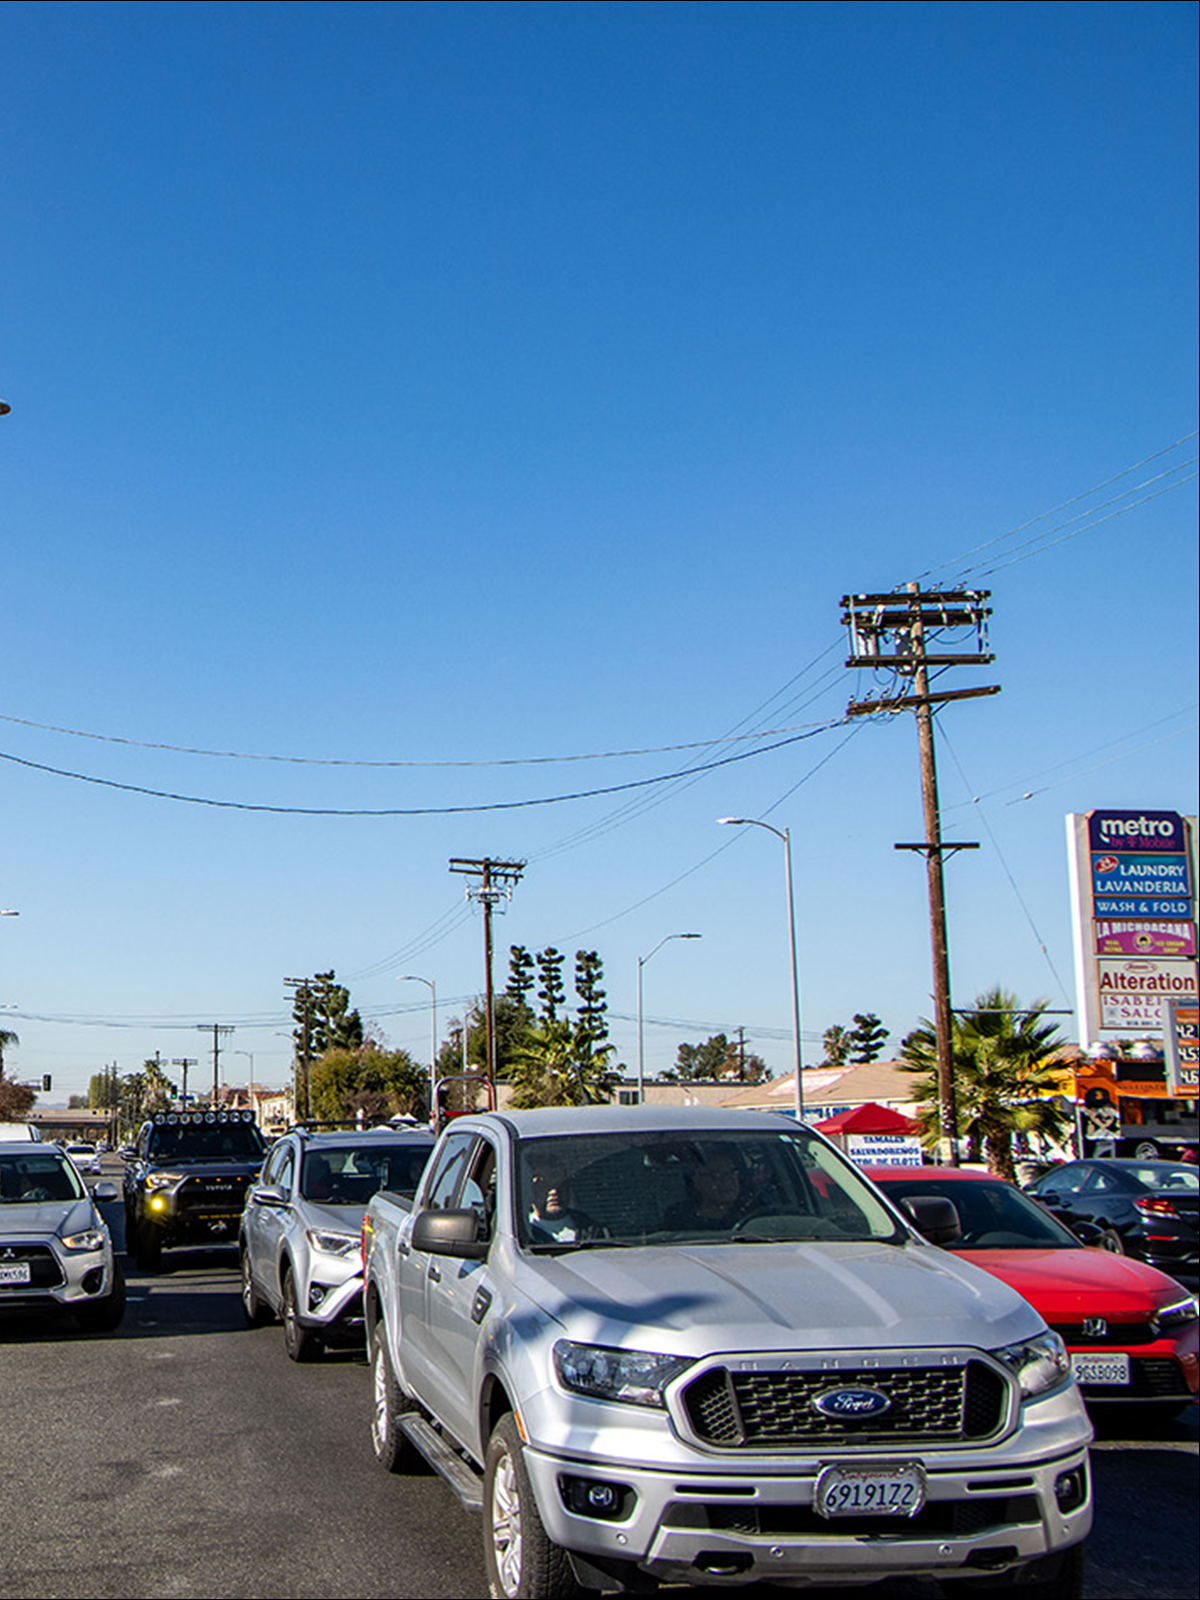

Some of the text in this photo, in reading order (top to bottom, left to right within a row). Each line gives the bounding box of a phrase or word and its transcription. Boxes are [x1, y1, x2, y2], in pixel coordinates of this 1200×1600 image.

[1100, 816, 1175, 837] metro
[1119, 865, 1185, 877] LAUNDRY
[1096, 881, 1187, 893] LAVANDERIA
[1096, 902, 1188, 913] WASH & FOLD
[1111, 922, 1192, 941] MICHOACANA
[1100, 972, 1196, 991] Alteration
[834, 1393, 876, 1412] Ford
